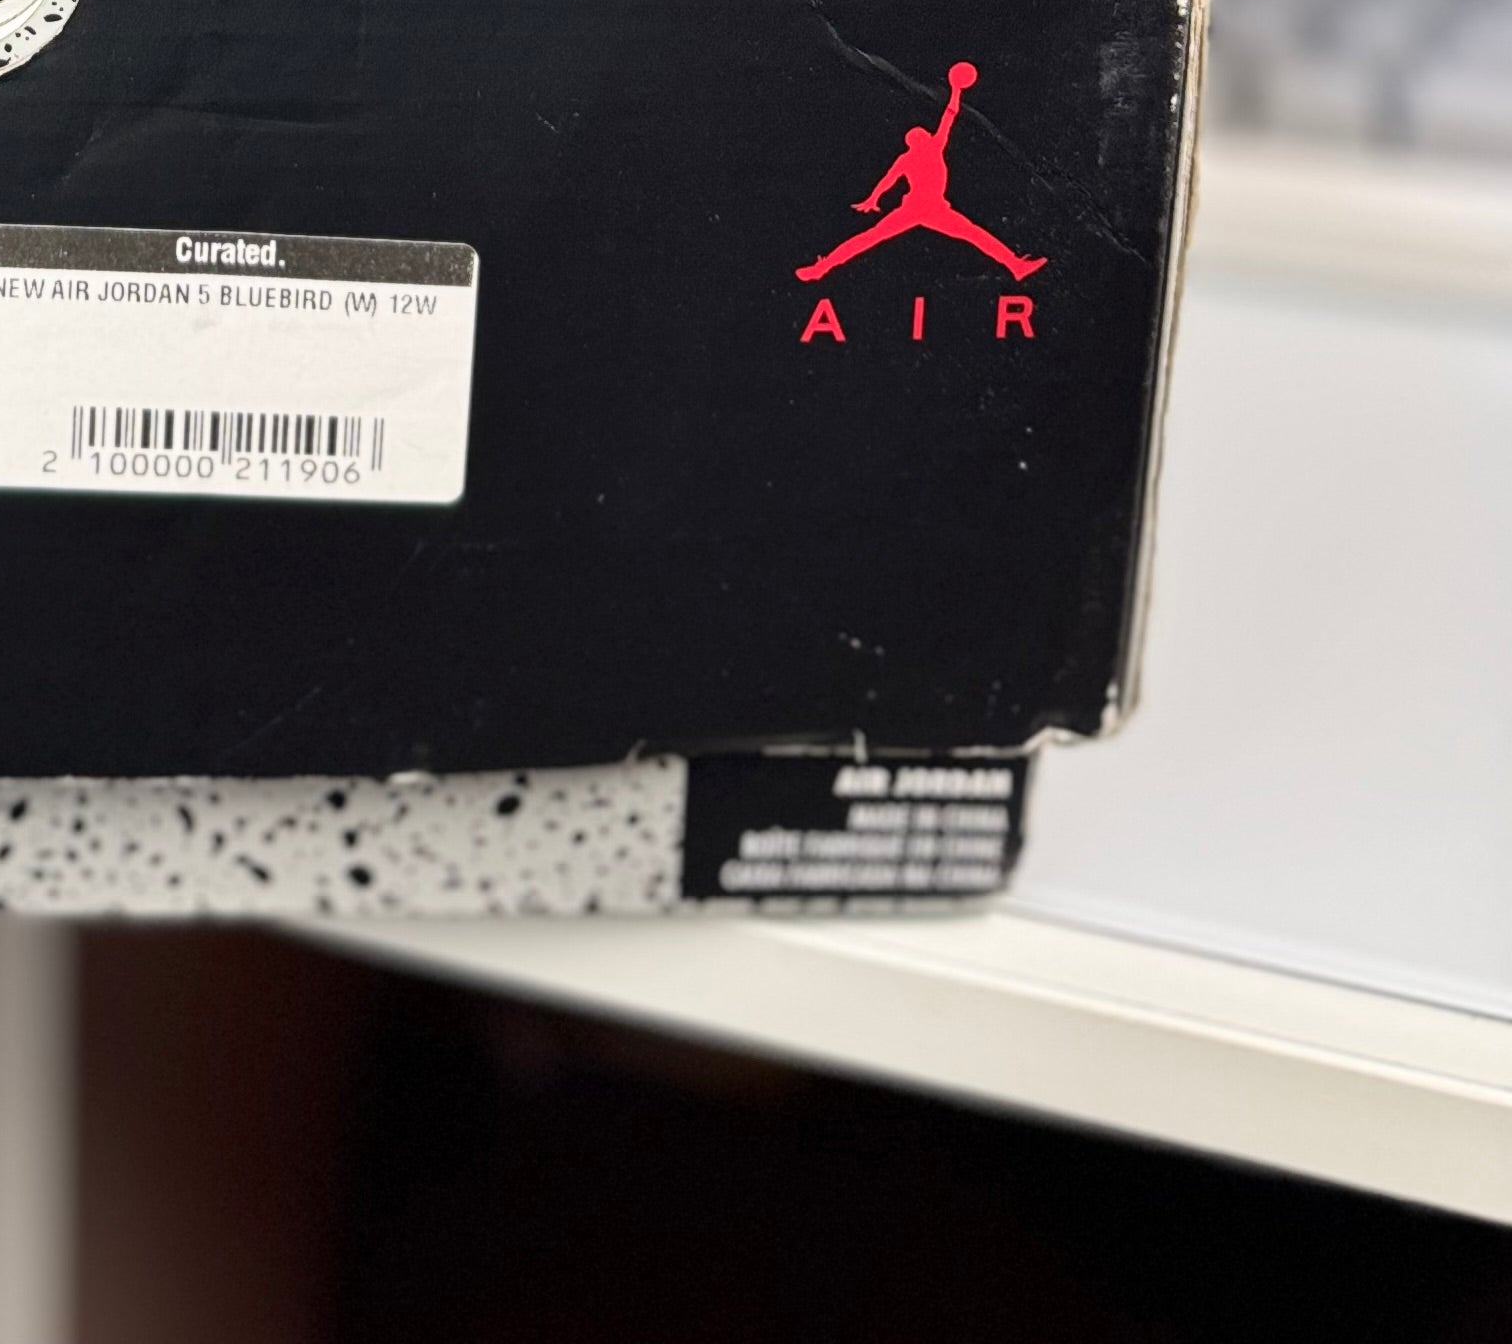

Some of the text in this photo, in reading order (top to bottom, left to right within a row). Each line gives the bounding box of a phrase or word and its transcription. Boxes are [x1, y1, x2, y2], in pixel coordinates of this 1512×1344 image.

[175, 236, 287, 268] Curated.
[51, 279, 90, 302] AIR
[97, 281, 191, 305] JORDAN
[198, 285, 211, 305] 5
[220, 285, 333, 311] BLUEBIRD
[344, 291, 378, 317] (W)
[389, 294, 438, 316] 12W
[800, 295, 1036, 343] AIR
[42, 450, 361, 485] 2 100000 211906
